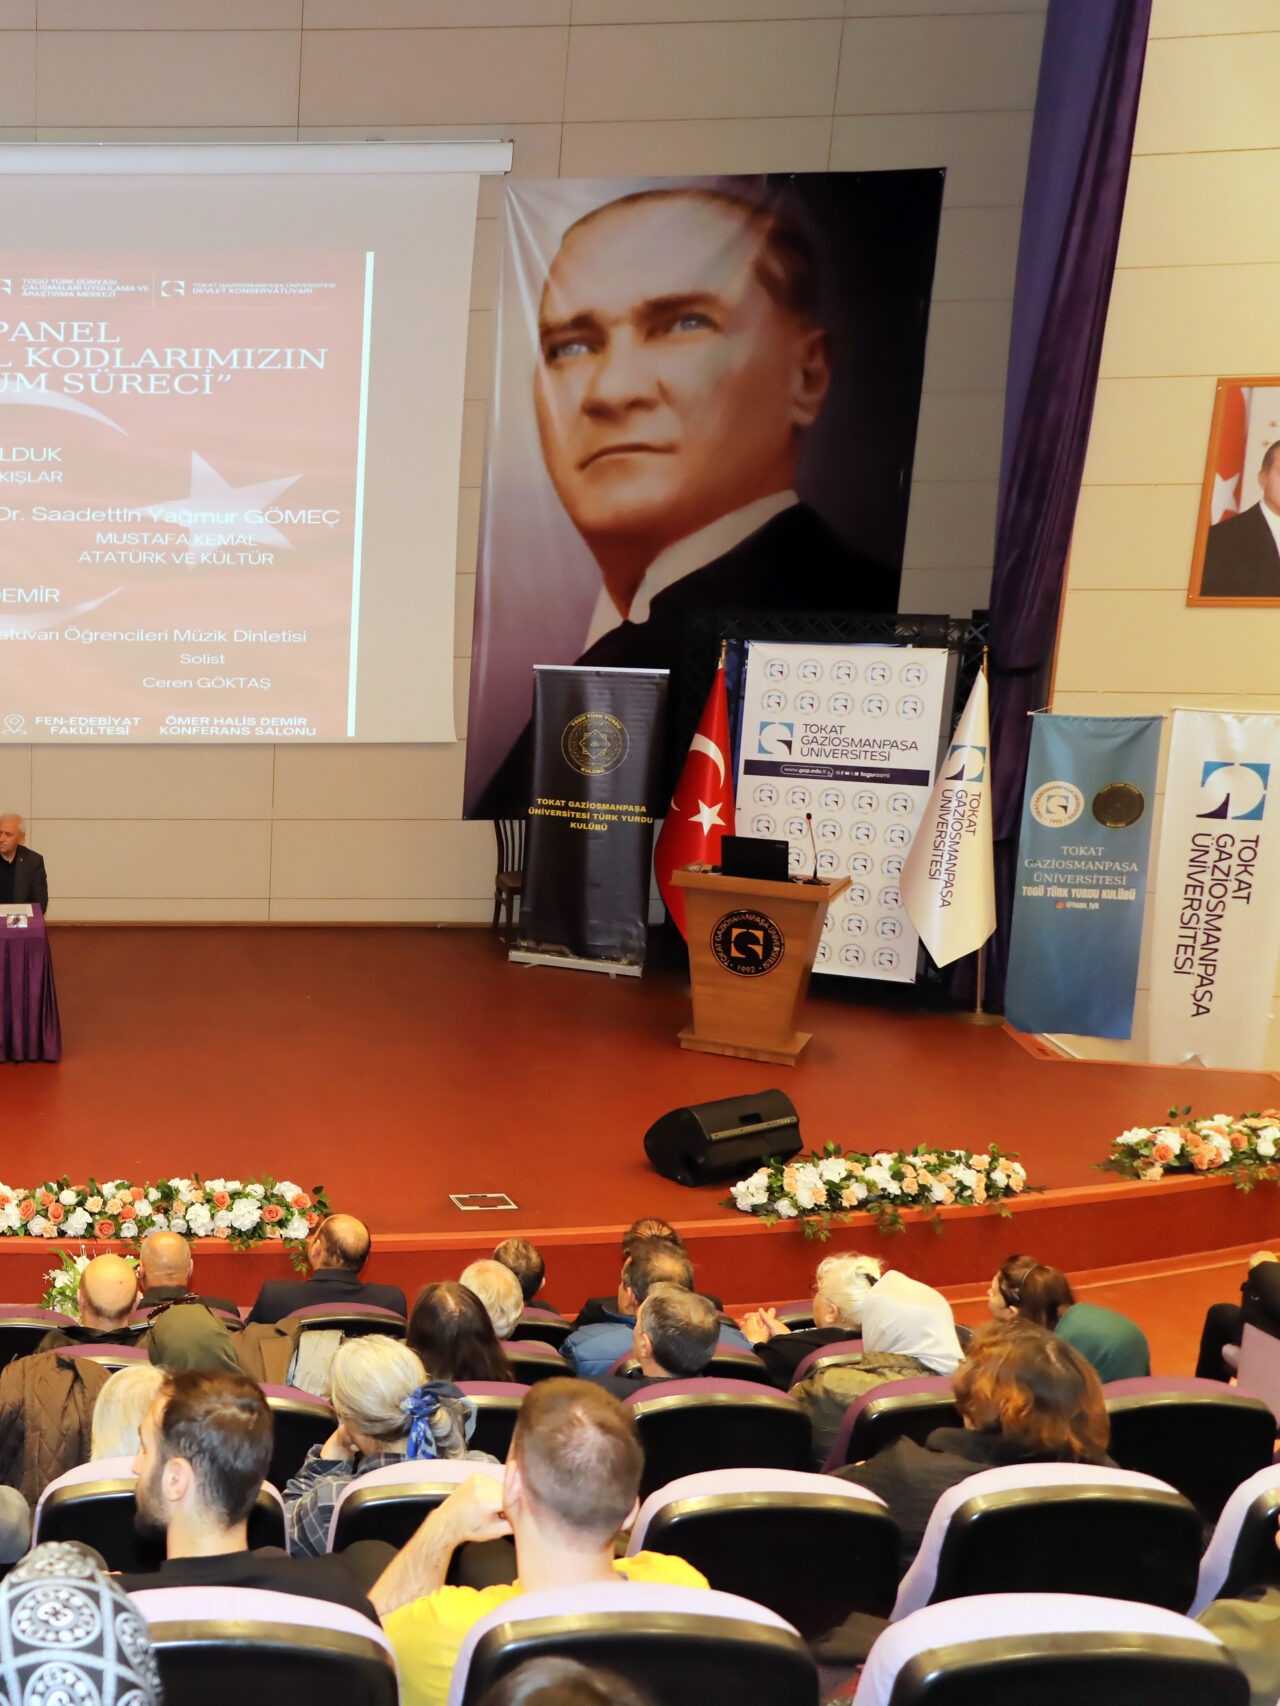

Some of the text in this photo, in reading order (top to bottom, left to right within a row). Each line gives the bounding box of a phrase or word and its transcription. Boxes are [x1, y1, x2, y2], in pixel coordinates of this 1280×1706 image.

[24, 347, 329, 370] KODLARIMIZIN
[63, 368, 233, 395] SÜRECİ”
[31, 506, 141, 523] Saadettin
[148, 507, 238, 527] Yağmur
[243, 506, 341, 528] GÖMEÇ
[95, 531, 258, 547] MUSTAFA KEMAL
[78, 549, 274, 566] ATATÜRK VE KÜLTÜR
[64, 625, 168, 643] Öğrencileri
[173, 627, 229, 643] Müzik
[233, 629, 307, 643] Dinletisi
[179, 653, 225, 665] Solist
[142, 675, 271, 690] Ceren GÖKTAŞ
[35, 715, 142, 727] FEN-EDEBİYAT
[166, 715, 308, 727] ÖMER HALİS DEMİR
[50, 724, 130, 736] FAKÜLTESİ
[159, 725, 317, 736] KONFERANS SALONU
[802, 723, 846, 735] TOKAT
[800, 735, 919, 752] GAZİOSMANPAŞA
[800, 745, 891, 762] ÜNİVERSİTESİ
[536, 798, 647, 813] TOKAT GAZİOSMANPAŞA
[528, 807, 654, 824] ÜNİVERSİTESİ TÜRK YURDU
[965, 791, 981, 836] TOKAT
[570, 821, 608, 831] KULÜBÜ
[1062, 846, 1105, 856] TOKAT
[1024, 859, 1139, 873] GAZİOSMANPAŞA
[1231, 834, 1260, 905] TOKAT
[1033, 872, 1127, 886] ÜNİVERSİTESİ
[1022, 885, 1137, 900] TOGÜ TÜRK YURDU KULÜBÜ
[1173, 833, 1213, 976] ÜNİVERSİTESİ
[1190, 833, 1235, 1018] GAZİOSMANPAŞA
